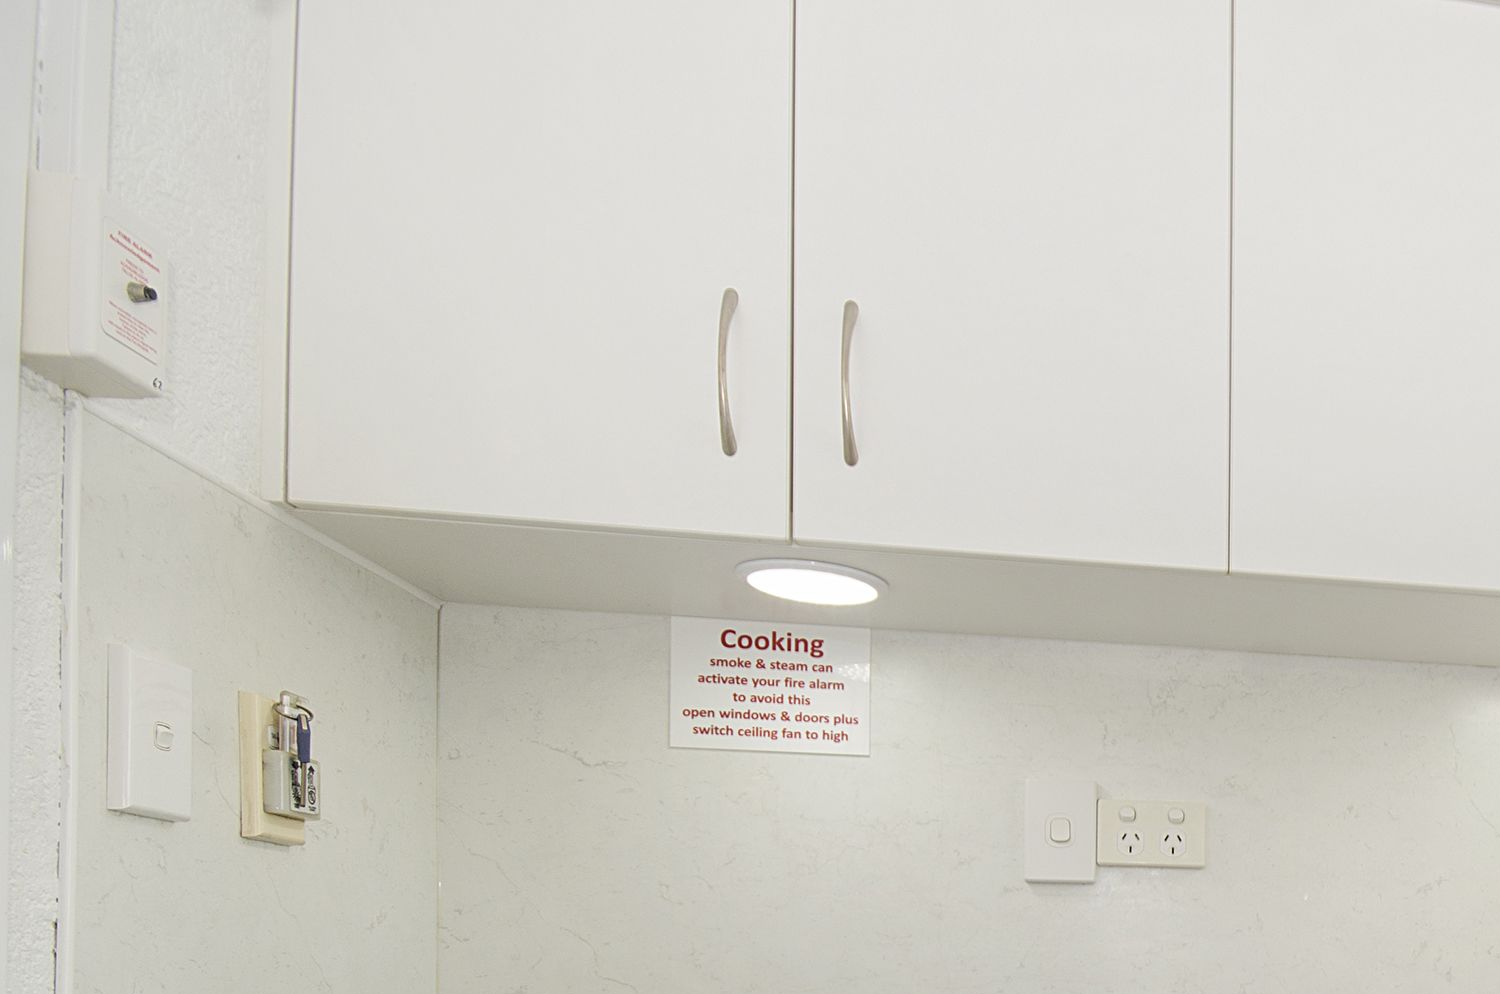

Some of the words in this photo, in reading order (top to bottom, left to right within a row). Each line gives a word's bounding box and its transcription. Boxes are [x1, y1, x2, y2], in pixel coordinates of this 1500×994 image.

[720, 629, 824, 658] Cooking
[710, 657, 752, 668] smoke
[755, 659, 766, 669] &
[770, 660, 807, 671] steam
[812, 662, 833, 673] can
[698, 673, 748, 685] activate
[752, 678, 780, 688] your
[785, 677, 805, 688] fire
[809, 679, 845, 690] alarm
[733, 692, 746, 702] to
[750, 693, 784, 704] avoid
[788, 694, 811, 705] this
[682, 708, 714, 720] open
[720, 709, 776, 721] windows
[780, 711, 790, 721] &
[795, 712, 830, 723] doors
[834, 713, 859, 725] plus
[693, 725, 733, 736] switch
[738, 727, 778, 740] ceiling
[782, 728, 801, 739] fan
[806, 730, 818, 739] to
[822, 730, 849, 742] high
